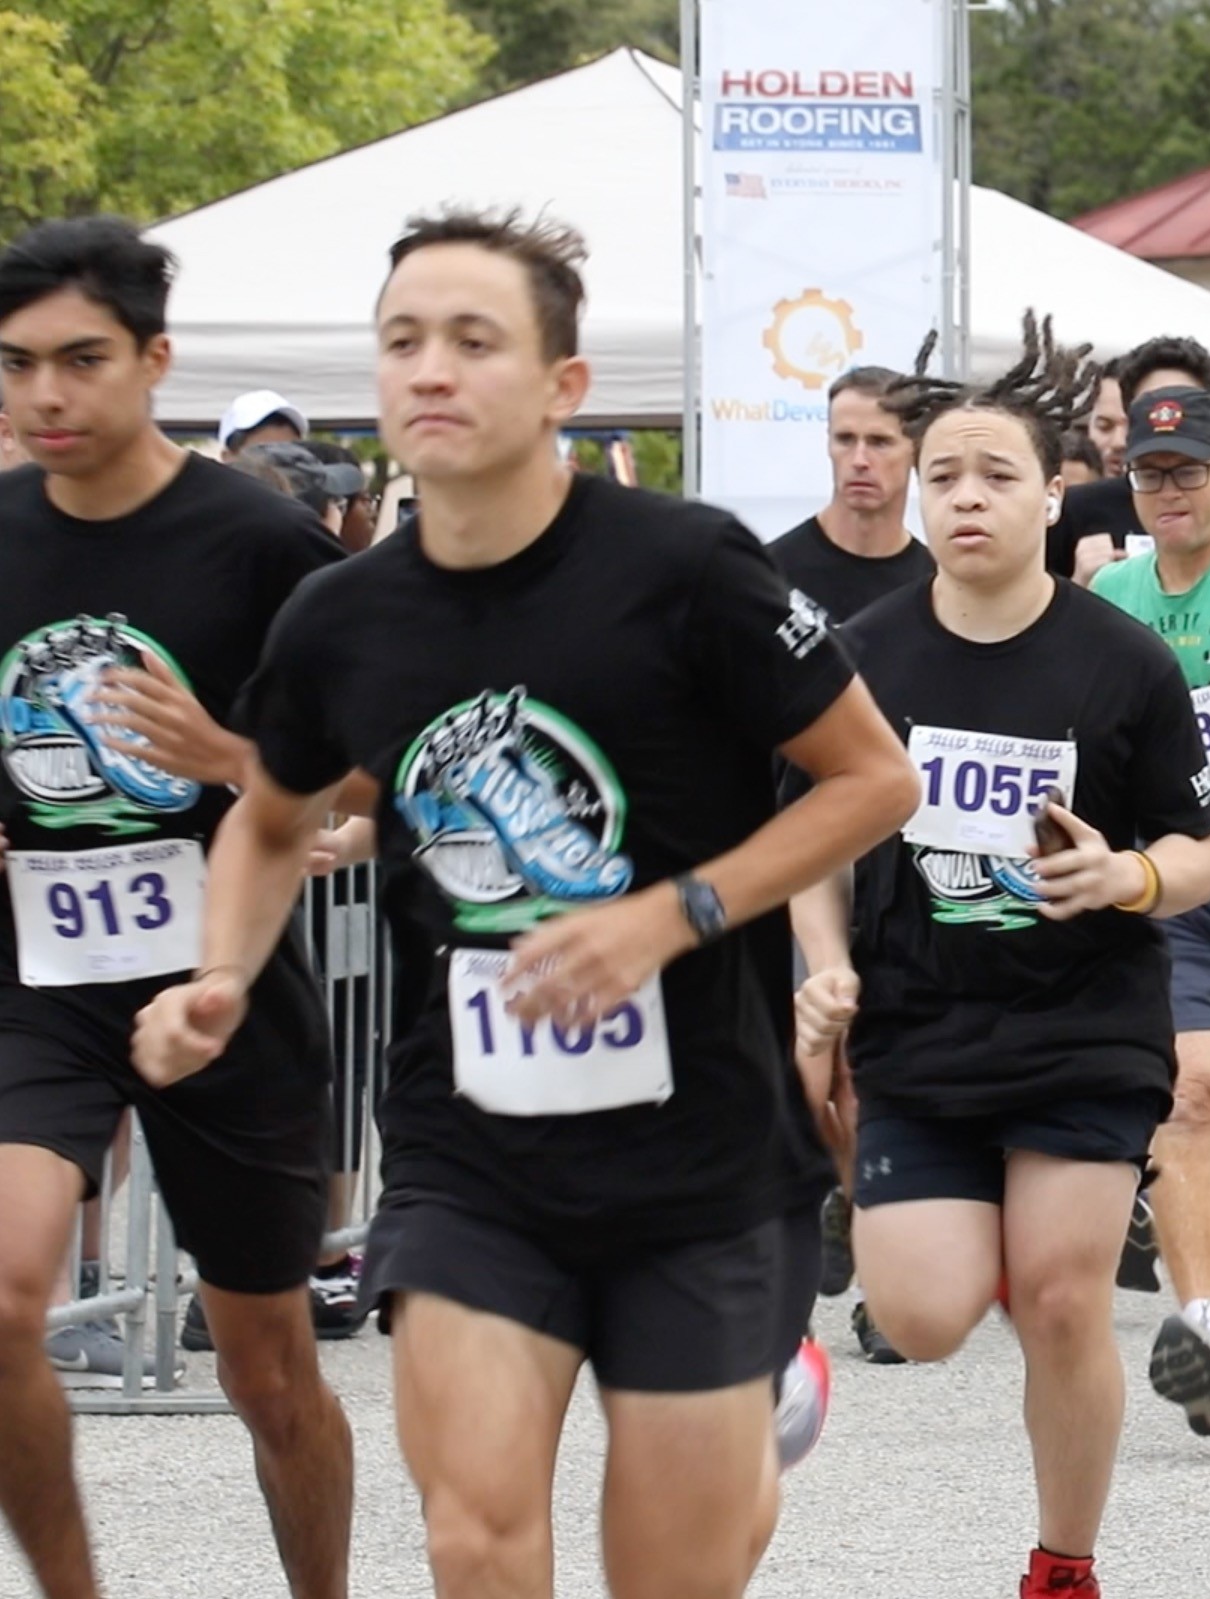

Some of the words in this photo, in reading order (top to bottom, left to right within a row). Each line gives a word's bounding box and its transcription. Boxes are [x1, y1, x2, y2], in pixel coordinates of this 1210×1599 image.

[721, 70, 914, 99] HOLDEN
[721, 106, 915, 136] ROOFING
[920, 756, 1060, 817] 1055
[47, 871, 173, 940] 913
